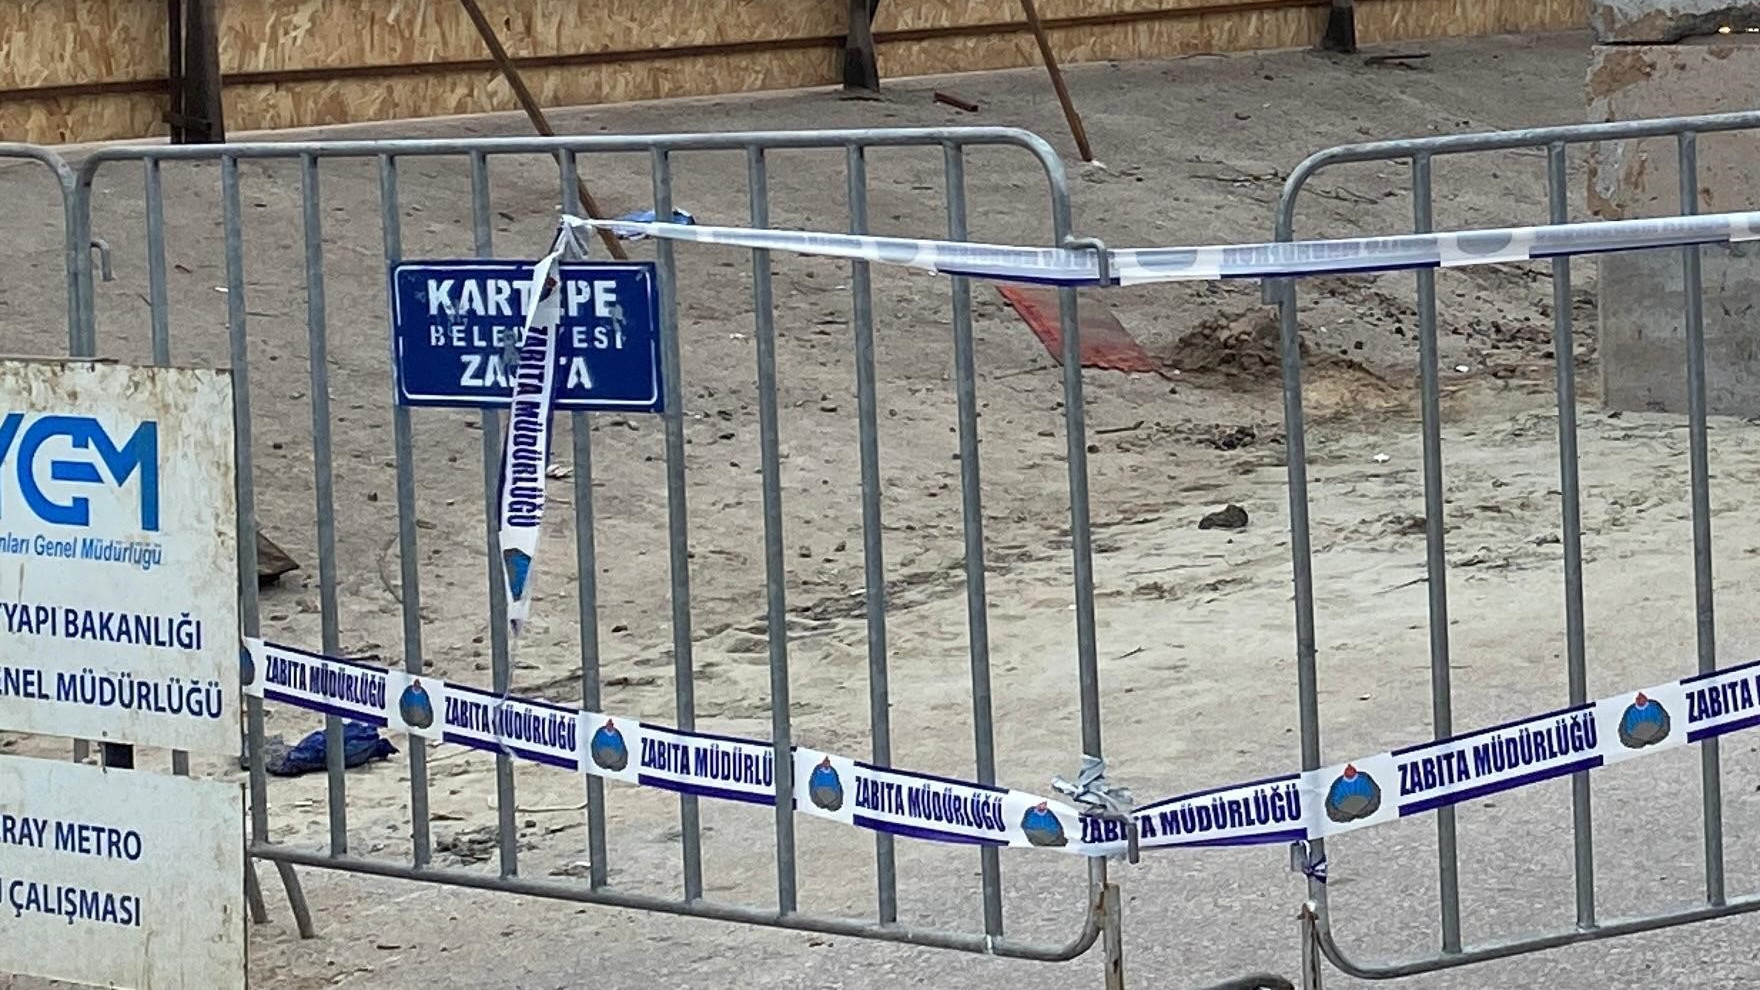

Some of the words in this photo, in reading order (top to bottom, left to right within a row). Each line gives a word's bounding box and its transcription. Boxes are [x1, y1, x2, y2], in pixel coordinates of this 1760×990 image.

[427, 278, 617, 317] KARTPE
[460, 354, 593, 389] ZAA
[507, 401, 544, 527] MÜDÜRLÜĞÜ
[34, 534, 78, 559] Genel
[81, 537, 163, 571] Müdürlüğü
[0, 602, 57, 637] YAPI
[64, 608, 202, 650] BAKANLIĞI
[0, 666, 50, 700] NEL
[56, 667, 223, 719] MÜDÜRLÜĞÜ
[265, 654, 307, 691] ZABITA
[309, 662, 386, 710] MÜDÜRLÜĞÜ
[1685, 677, 1753, 724] ZABITA
[444, 696, 491, 733] ZABITA
[492, 703, 577, 752] MÜDÜRLÜĞÜ
[640, 737, 691, 776] ZABITA
[694, 743, 796, 787] MÜDÜRLÜ
[1397, 749, 1471, 797] ZABITA
[1473, 711, 1598, 778] MÜDÜRLÜĞÜ
[855, 775, 905, 816] ZABITA
[907, 782, 1006, 832] MÜDÜRLÜĞÜ
[1078, 811, 1157, 844] ZABIA
[1159, 782, 1301, 835] MÜDÜRLÜĞÜ
[0, 814, 48, 848] RAY
[55, 821, 142, 861] METRO
[9, 879, 141, 927] ÇALIŞMASI
